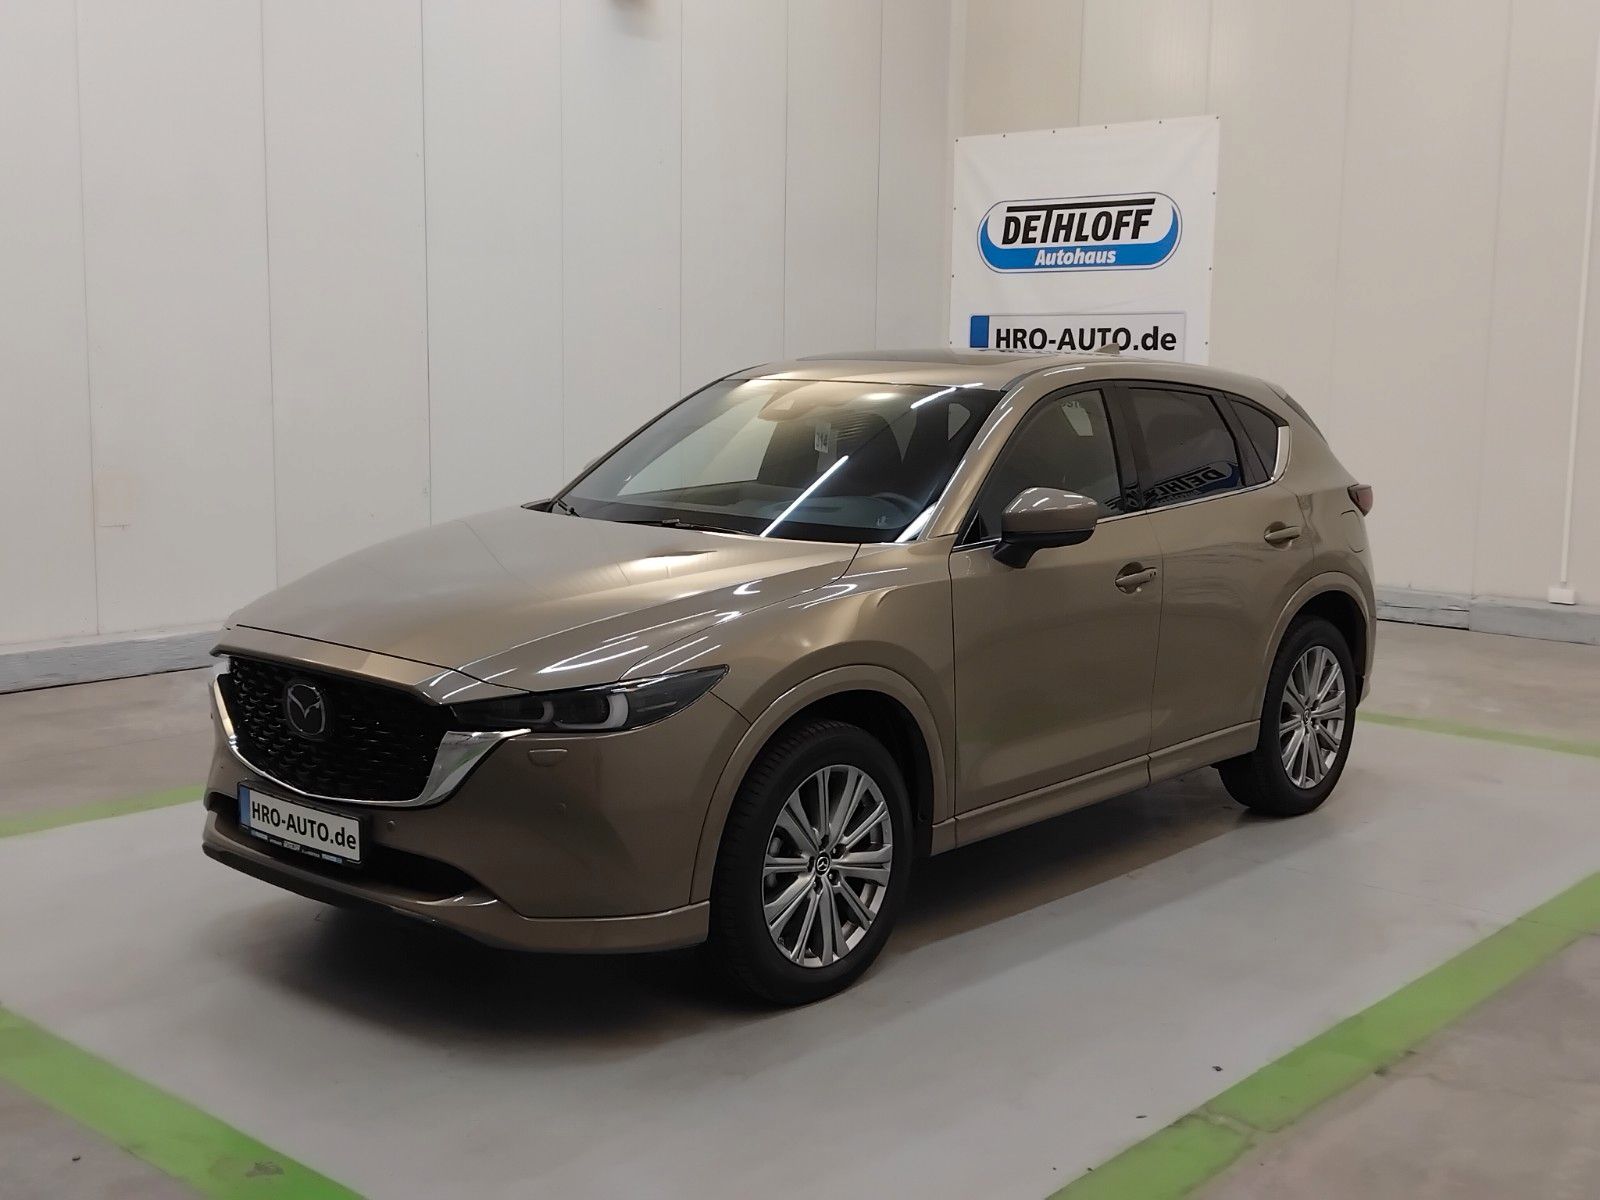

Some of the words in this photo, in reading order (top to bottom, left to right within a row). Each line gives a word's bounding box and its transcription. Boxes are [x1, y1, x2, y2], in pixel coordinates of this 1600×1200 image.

[1001, 198, 1156, 245] DETHLOFF
[1034, 247, 1117, 266] Autohaus
[996, 326, 1177, 351] HRO-AUTO.de
[252, 801, 357, 849] HRO-AUTO.de
